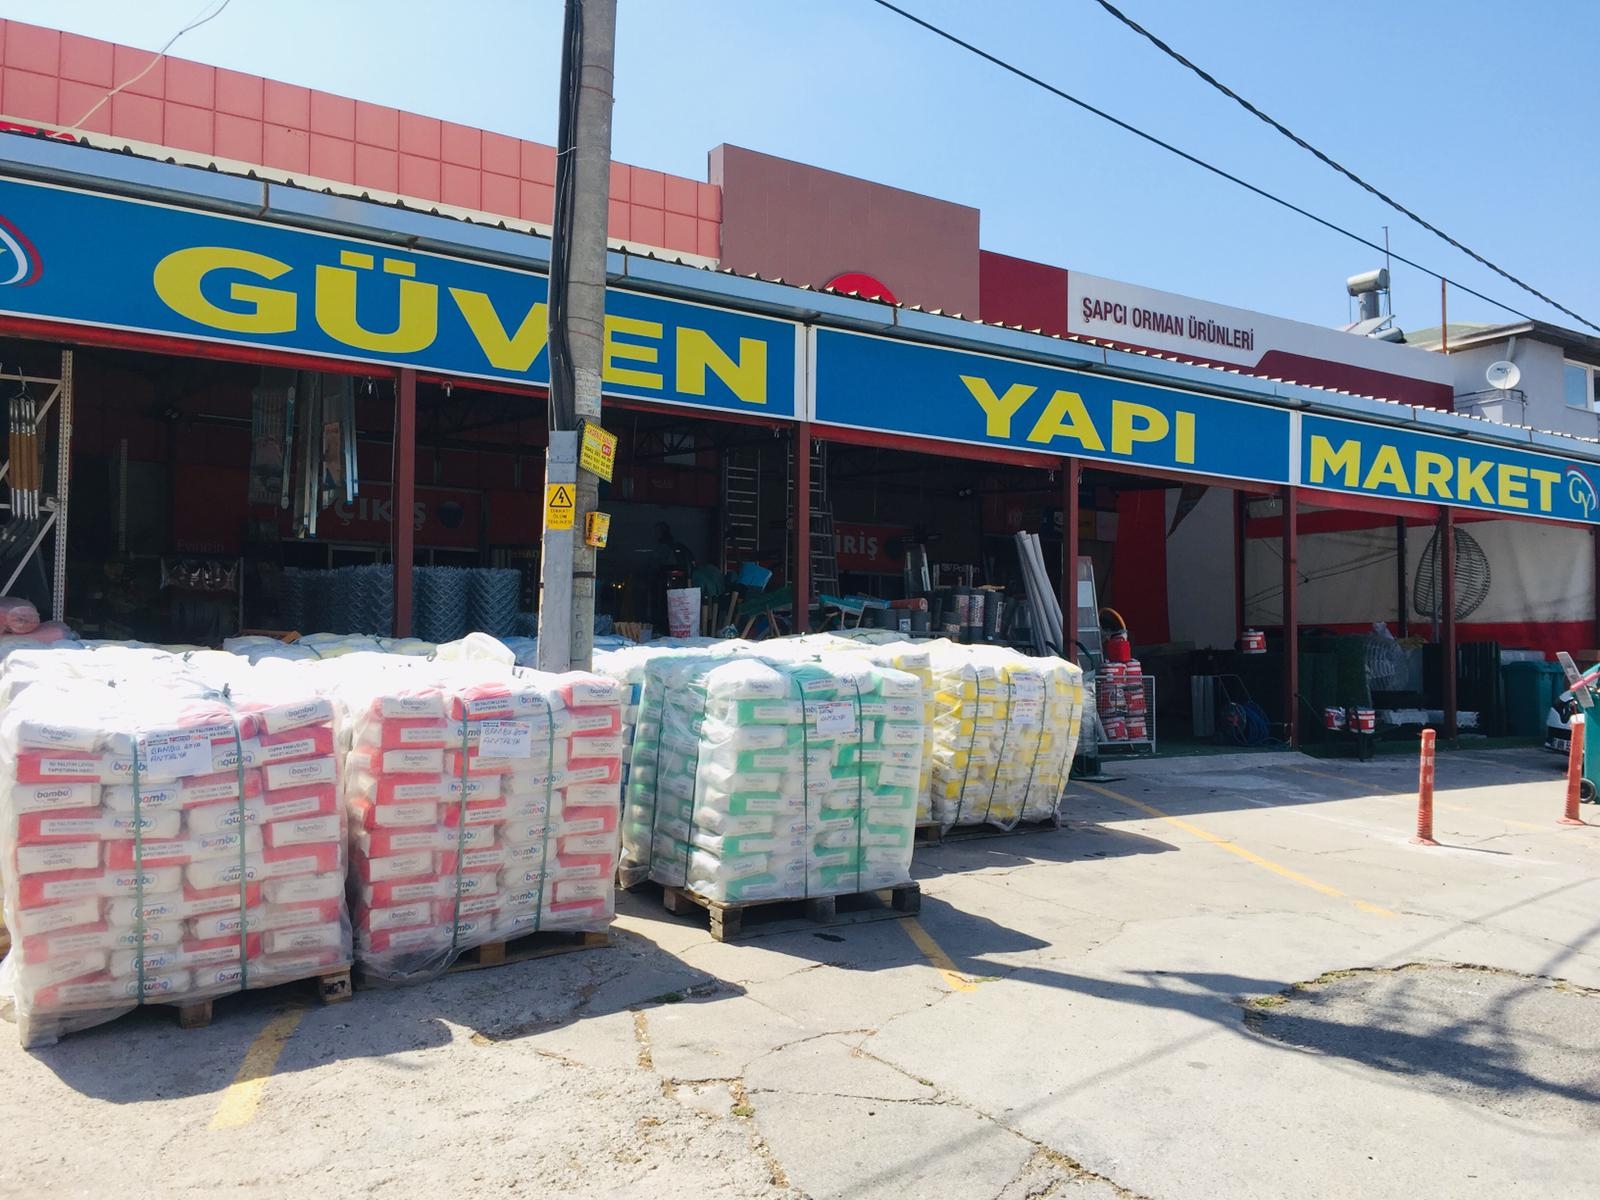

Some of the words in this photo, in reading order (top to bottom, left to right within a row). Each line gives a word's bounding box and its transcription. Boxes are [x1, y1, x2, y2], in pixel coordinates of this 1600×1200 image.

[1082, 297, 1127, 325] ŞAPCI
[1132, 307, 1184, 337] ORMAN
[1187, 315, 1254, 351] ÜRÜNLERİ
[152, 244, 768, 406] GÜVEN
[960, 375, 1196, 467] YAPI
[1308, 434, 1561, 513] MARKET
[590, 686, 613, 696] bambu
[403, 699, 427, 707] bambu
[893, 704, 914, 713] bambu
[288, 705, 316, 718] bambu
[892, 751, 912, 760] bambu
[294, 764, 319, 775] bambu
[37, 788, 70, 799] bambu
[201, 835, 238, 849] bambu
[512, 846, 541, 858] bambu
[510, 889, 540, 902] bambu
[391, 909, 417, 919] bambu
